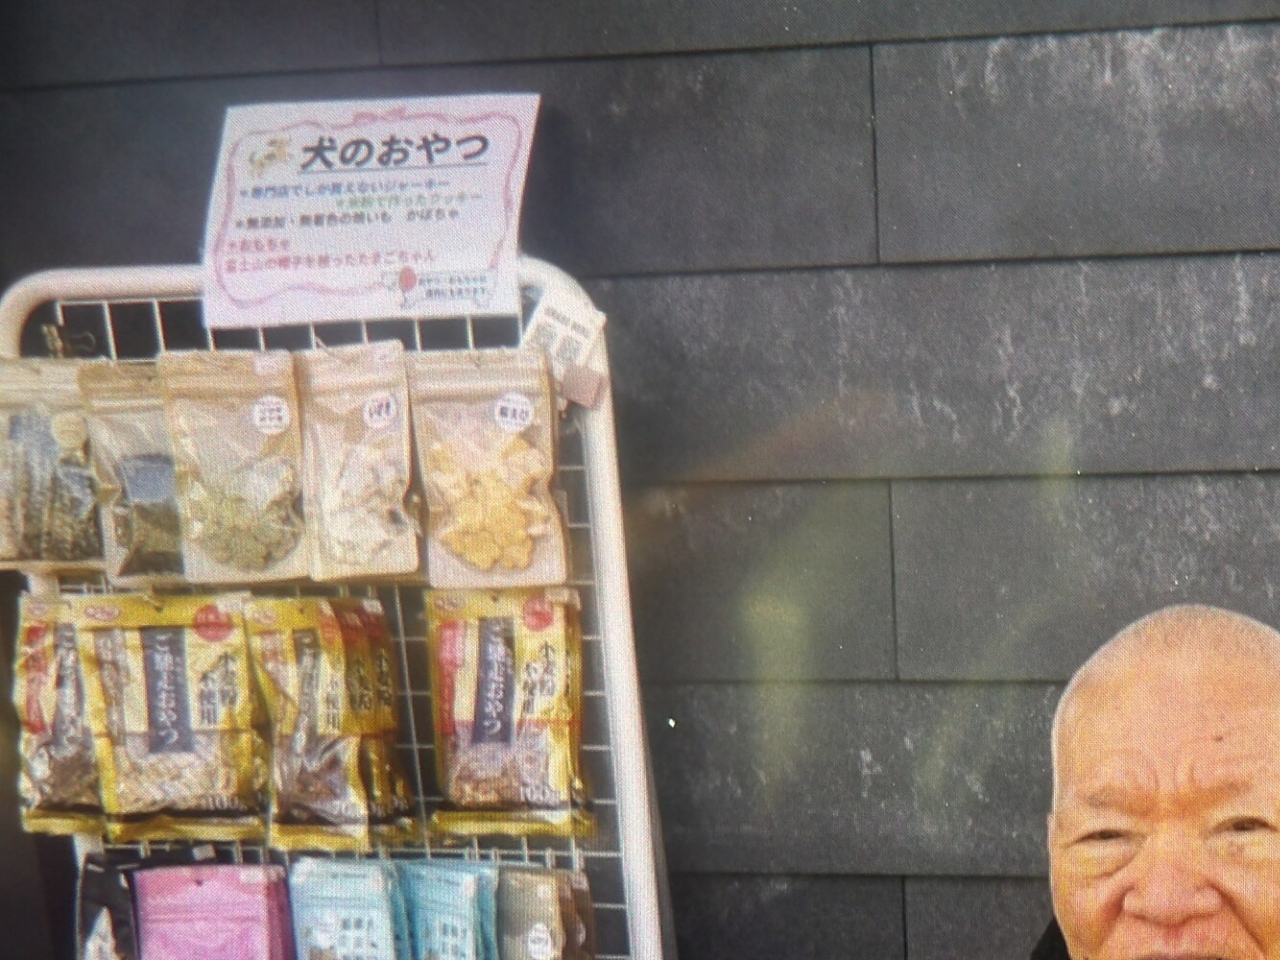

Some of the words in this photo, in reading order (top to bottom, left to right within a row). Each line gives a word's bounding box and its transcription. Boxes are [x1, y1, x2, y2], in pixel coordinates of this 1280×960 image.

[301, 131, 489, 170] 犬のおやつ
